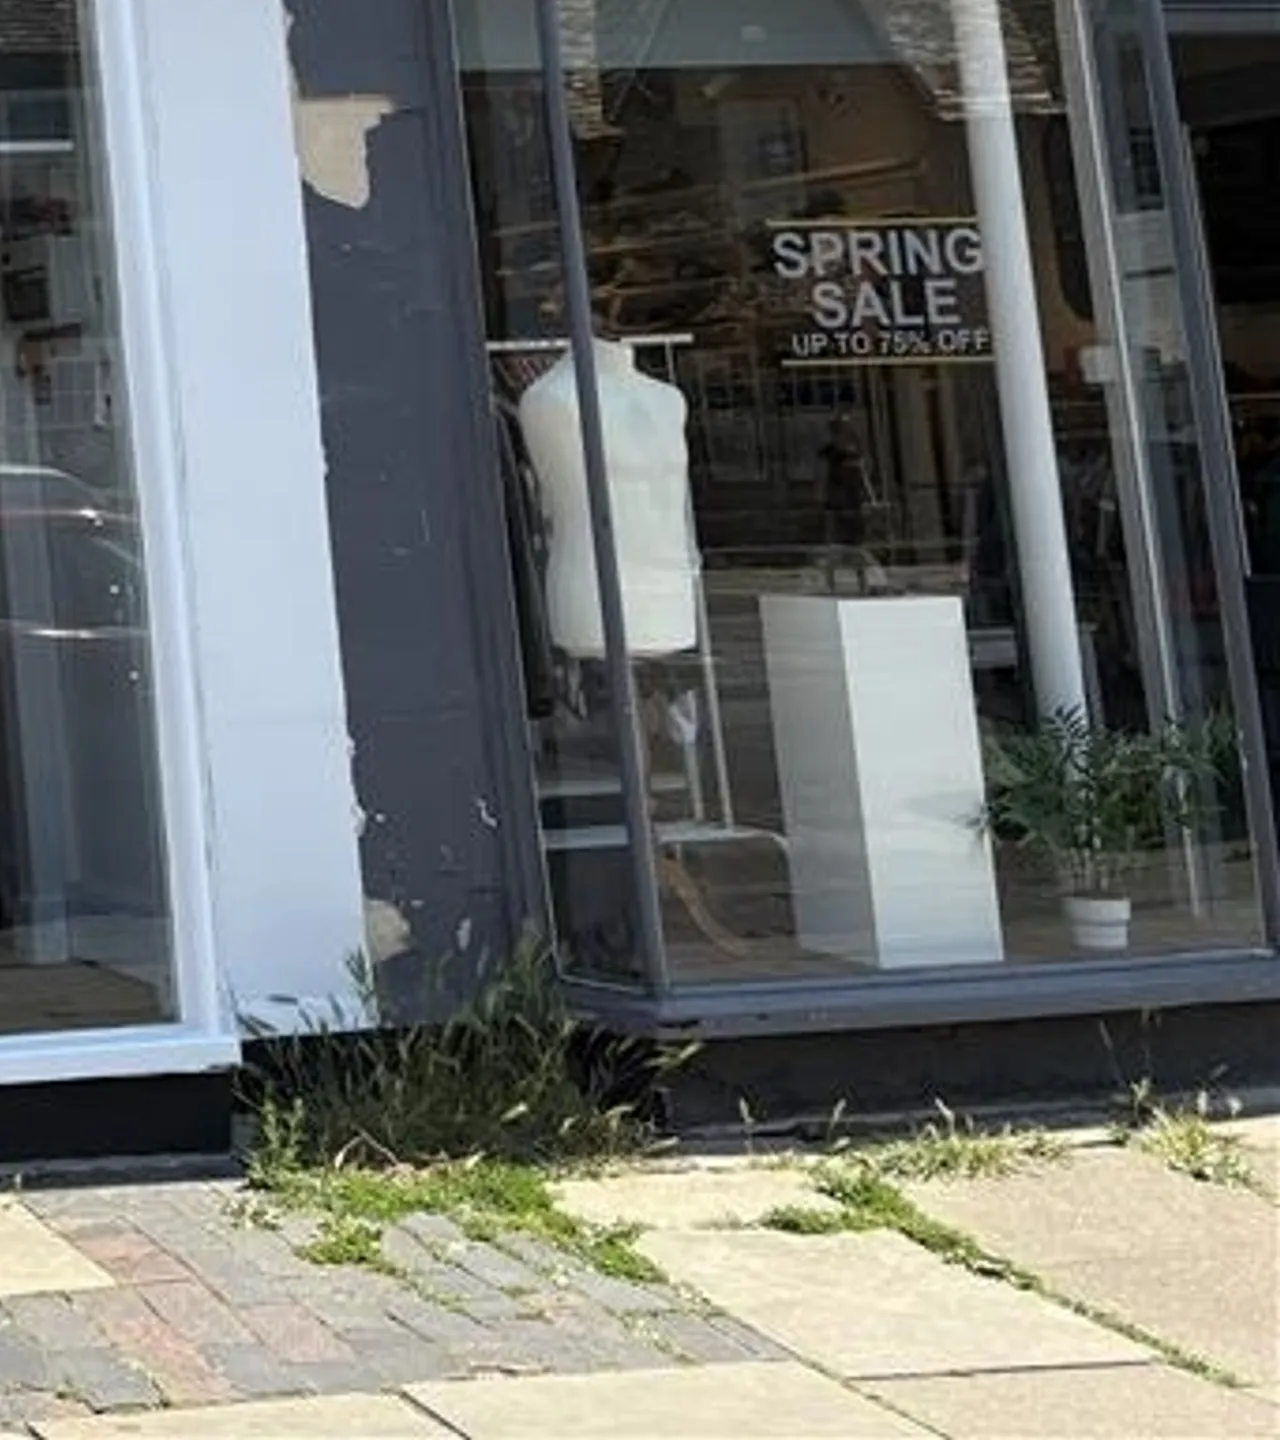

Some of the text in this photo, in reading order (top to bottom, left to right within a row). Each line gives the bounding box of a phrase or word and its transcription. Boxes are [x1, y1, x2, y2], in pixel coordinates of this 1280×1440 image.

[772, 228, 983, 278] SPRING
[812, 278, 962, 328] SALE
[791, 329, 991, 356] UP TO 75% OFF
